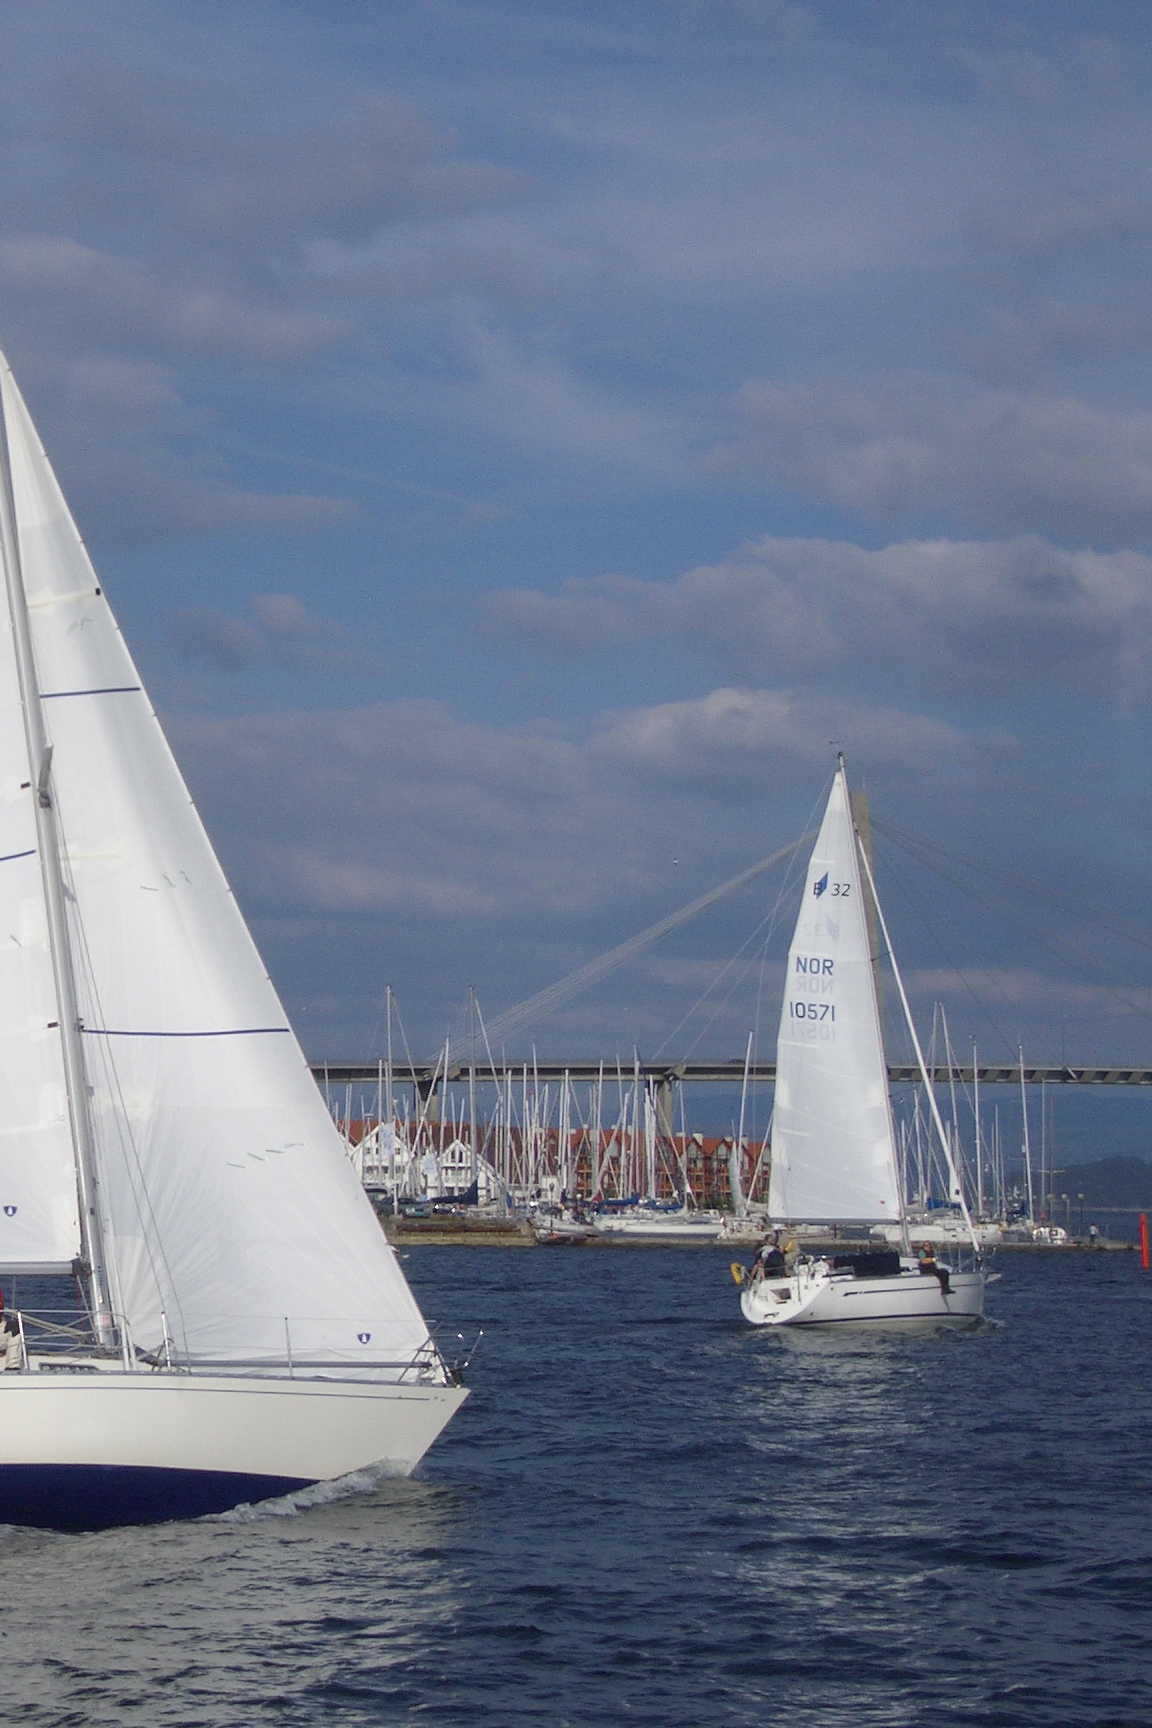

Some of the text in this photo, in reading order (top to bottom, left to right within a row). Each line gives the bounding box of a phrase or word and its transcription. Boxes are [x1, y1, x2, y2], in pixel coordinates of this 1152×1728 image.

[831, 883, 851, 897] 32
[795, 956, 834, 976] NOR
[789, 1001, 835, 1022] 10571
